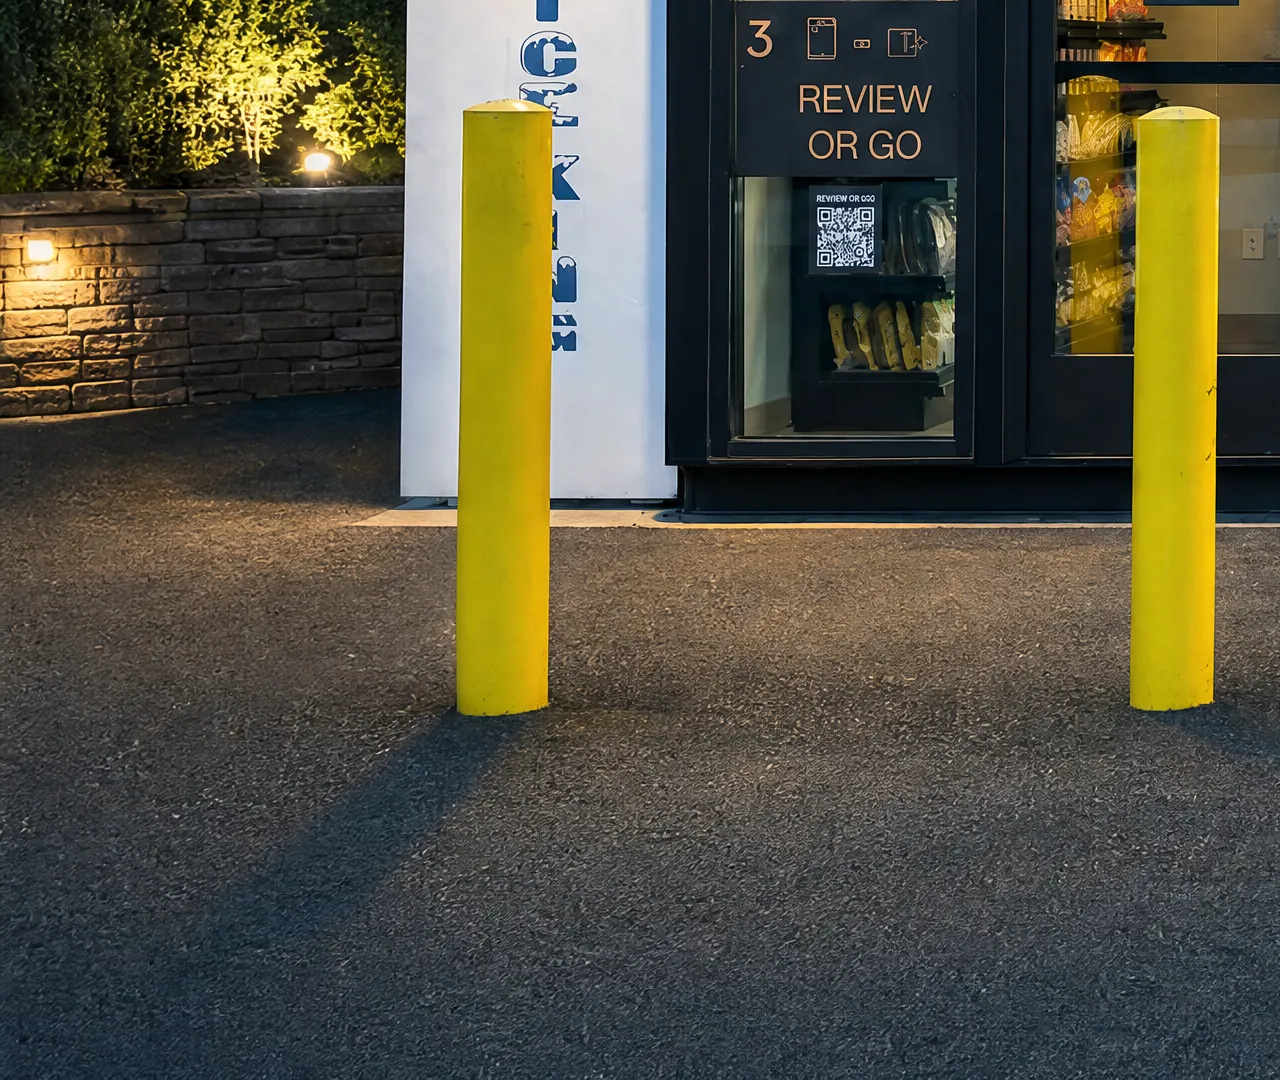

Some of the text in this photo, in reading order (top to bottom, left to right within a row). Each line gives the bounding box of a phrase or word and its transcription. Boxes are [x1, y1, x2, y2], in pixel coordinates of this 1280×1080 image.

[746, 19, 773, 58] 3
[799, 84, 933, 114] REVIEW
[808, 129, 922, 160] OR GO
[848, 194, 860, 203] OR
